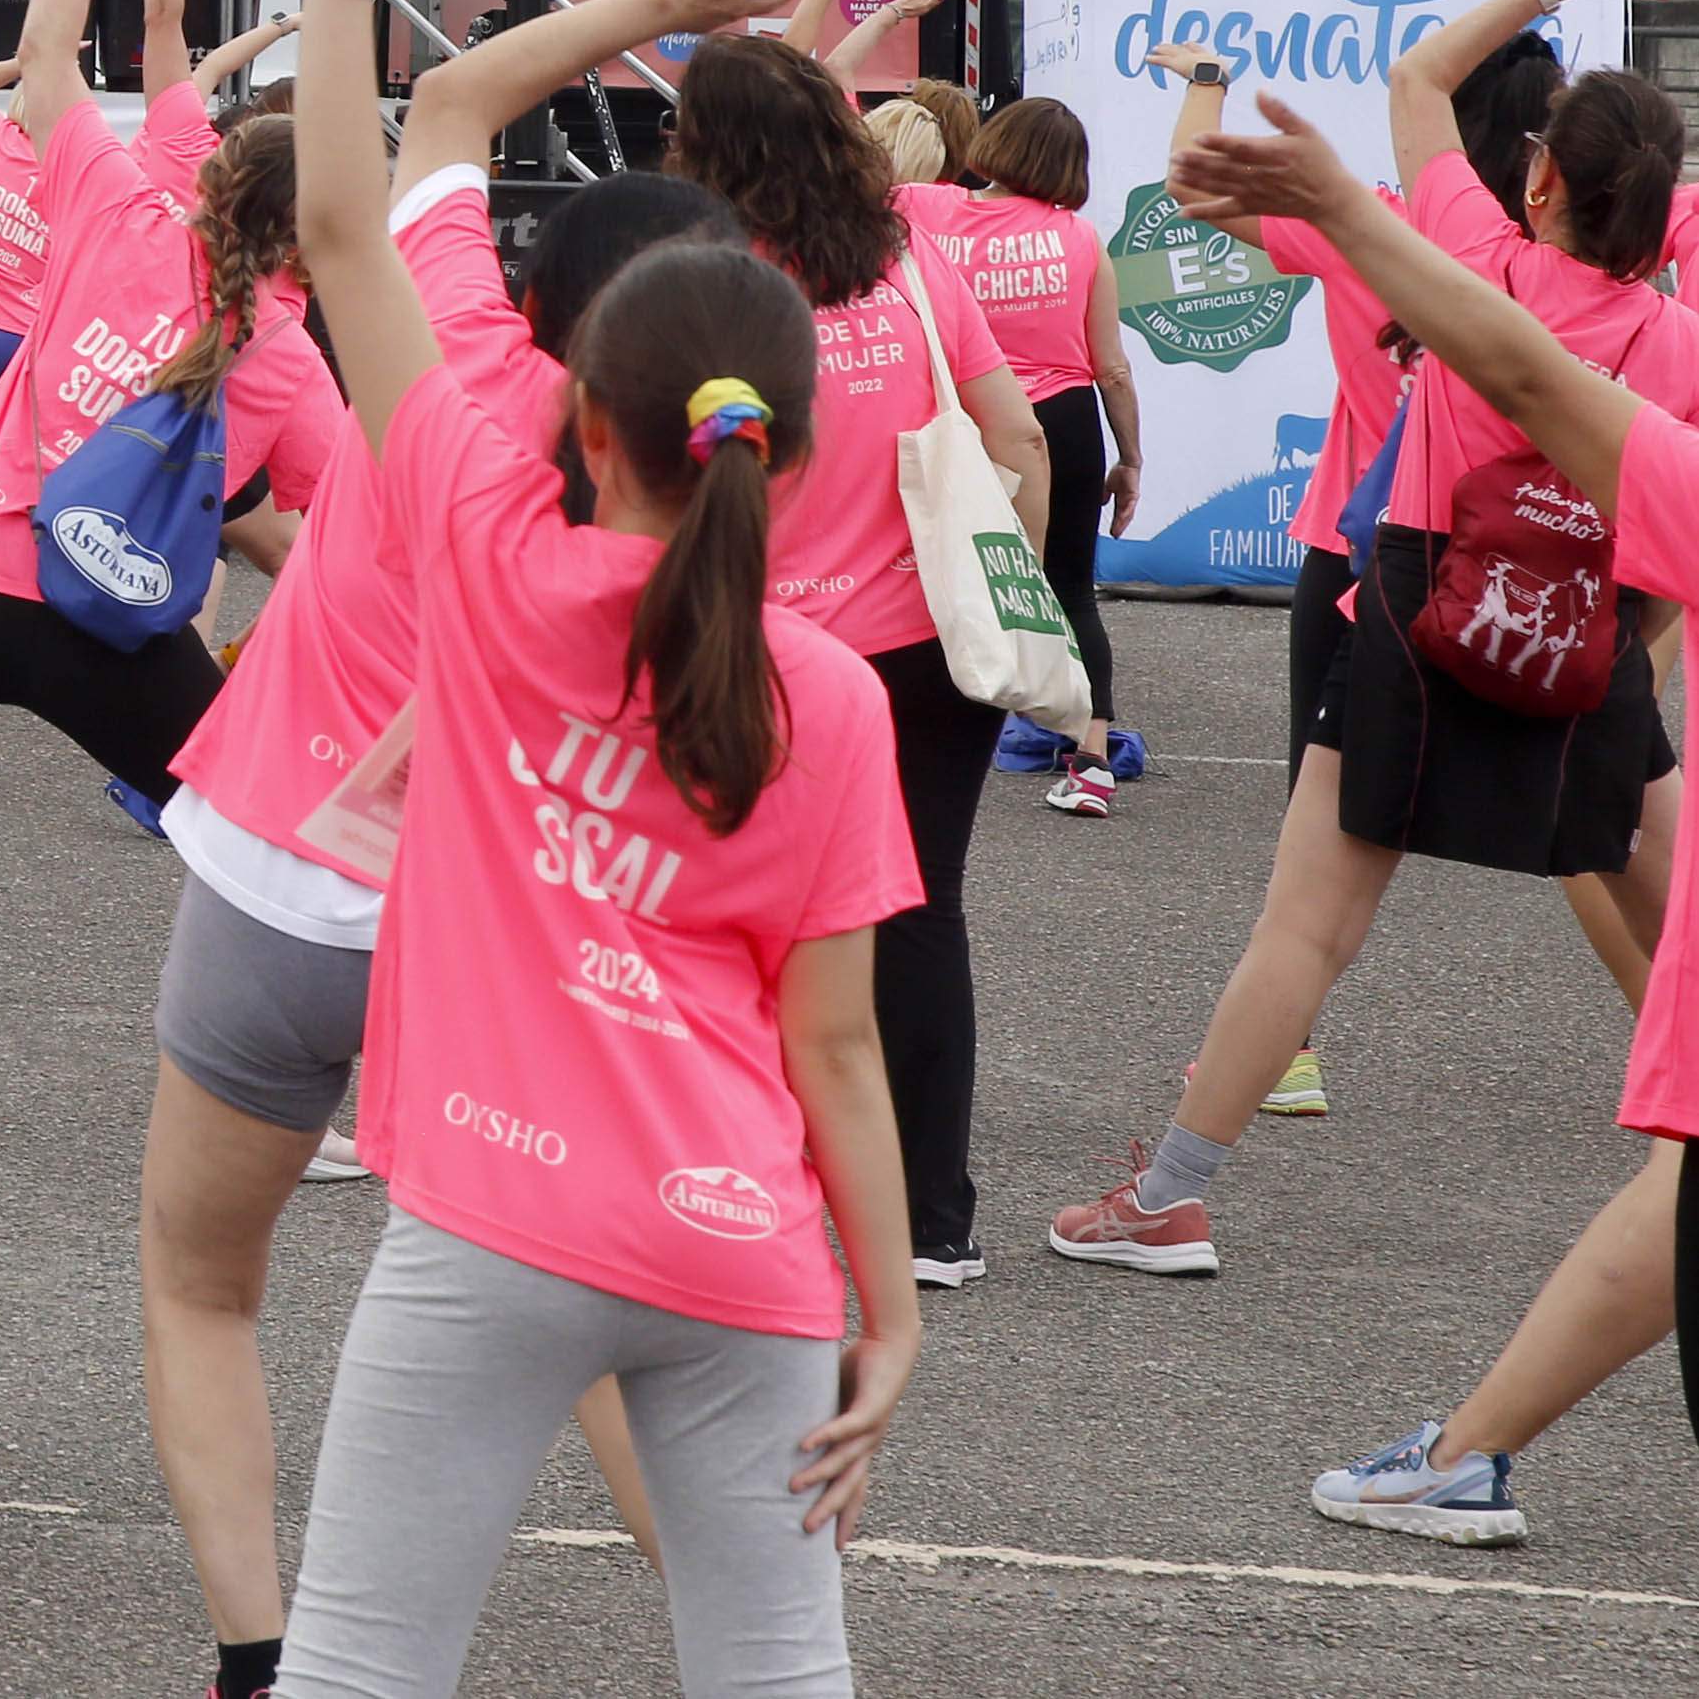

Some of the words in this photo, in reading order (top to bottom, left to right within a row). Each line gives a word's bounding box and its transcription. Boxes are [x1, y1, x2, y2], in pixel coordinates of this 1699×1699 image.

[987, 230, 1064, 264] GANAN
[1164, 225, 1199, 245] SIN
[974, 263, 1068, 300] CHICAS!
[987, 303, 1002, 313] LA
[1004, 300, 1040, 312] MUJER
[1145, 309, 1183, 345] 100%
[1186, 286, 1287, 351] NATURALES
[1176, 289, 1257, 315] ARTIFICIALES
[139, 313, 186, 363] TU
[819, 322, 856, 346] DE
[859, 318, 895, 340] LA
[818, 343, 905, 375] MUJER
[848, 378, 885, 395] 2022
[1267, 484, 1293, 524] DE
[59, 517, 160, 599] ASTURIANA
[984, 546, 1007, 577] NO
[776, 574, 856, 598] OYSHO
[996, 584, 1035, 619] MÁS
[544, 709, 647, 811] TU
[578, 938, 662, 1003] 2024
[444, 1091, 568, 1167] OYSHO
[667, 1179, 777, 1229] ASTURIANA
